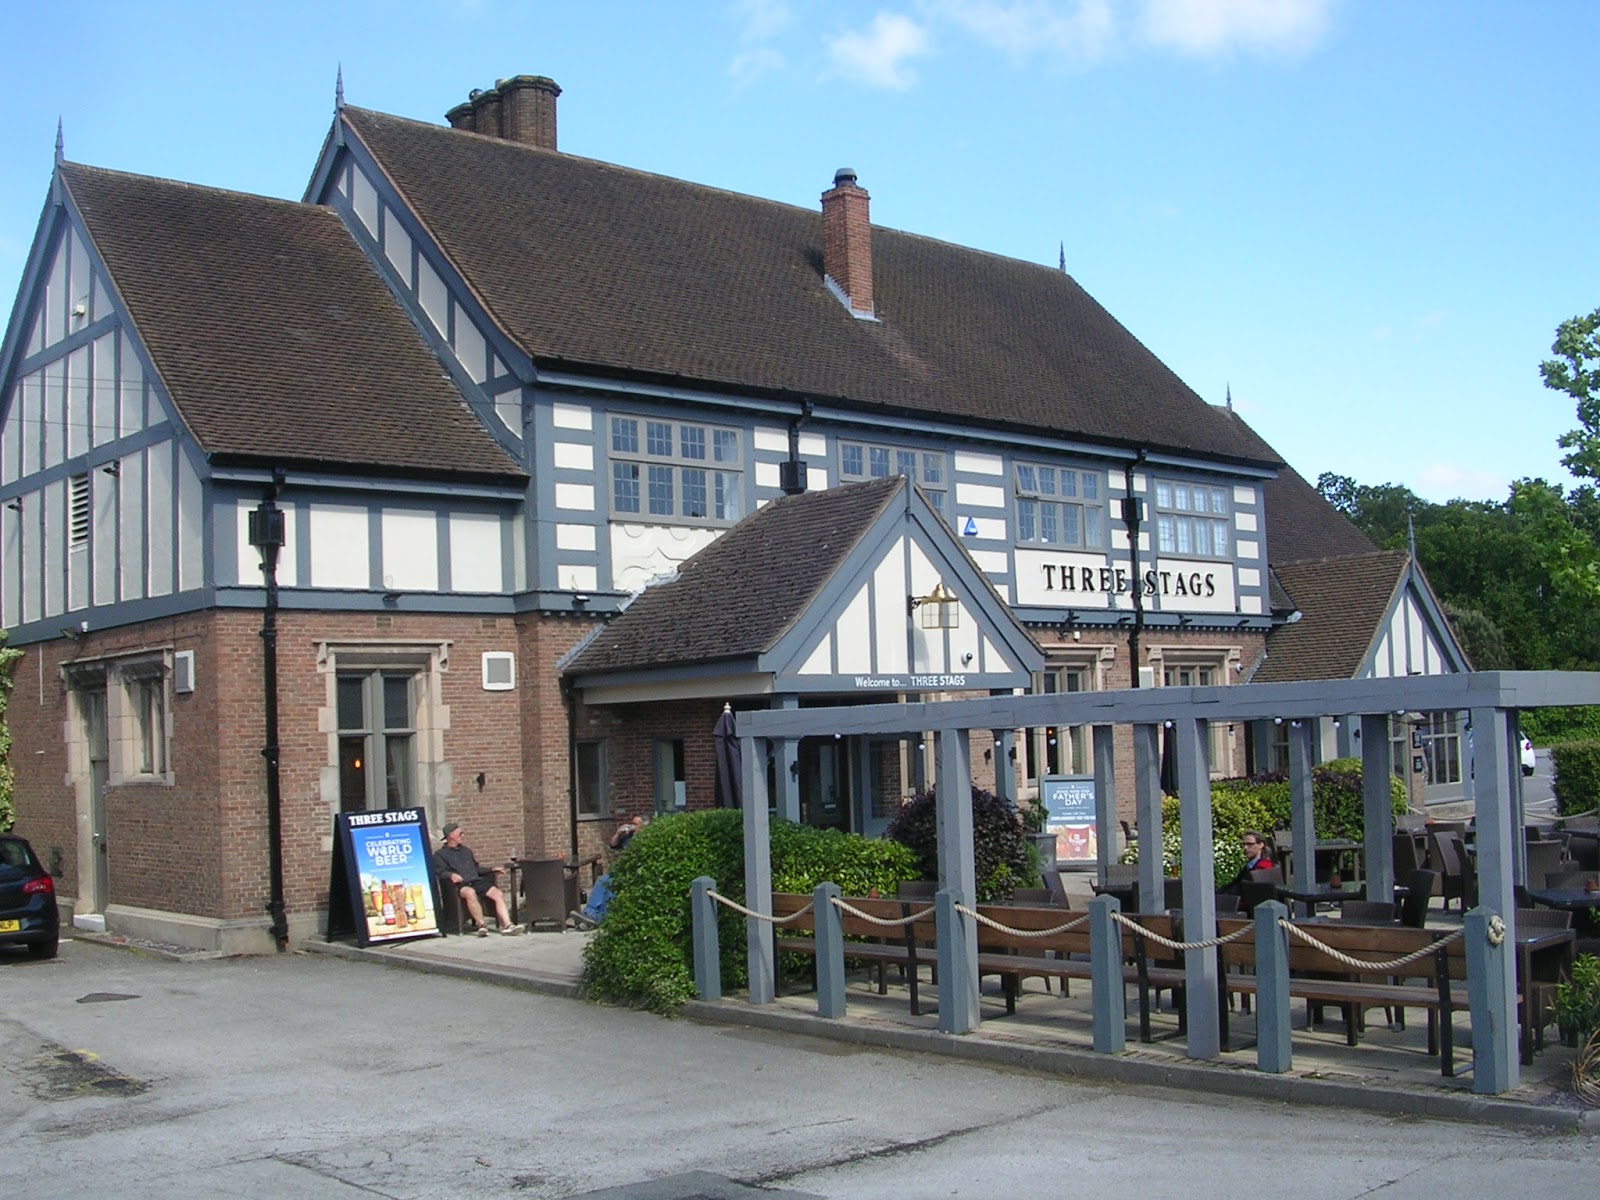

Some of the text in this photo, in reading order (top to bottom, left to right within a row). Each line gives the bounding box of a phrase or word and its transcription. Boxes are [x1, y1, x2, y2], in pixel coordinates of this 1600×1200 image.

[1042, 563, 1216, 597] THREE STAGS
[855, 676, 890, 687] Welcome
[910, 675, 939, 686] THREE
[940, 675, 965, 686] STAGS
[1053, 792, 1094, 800] FATHER'S
[348, 811, 418, 826] THREE STAGS
[365, 838, 411, 848] CELEBRATING
[367, 844, 412, 857] WORLD
[375, 854, 407, 866] BEER
